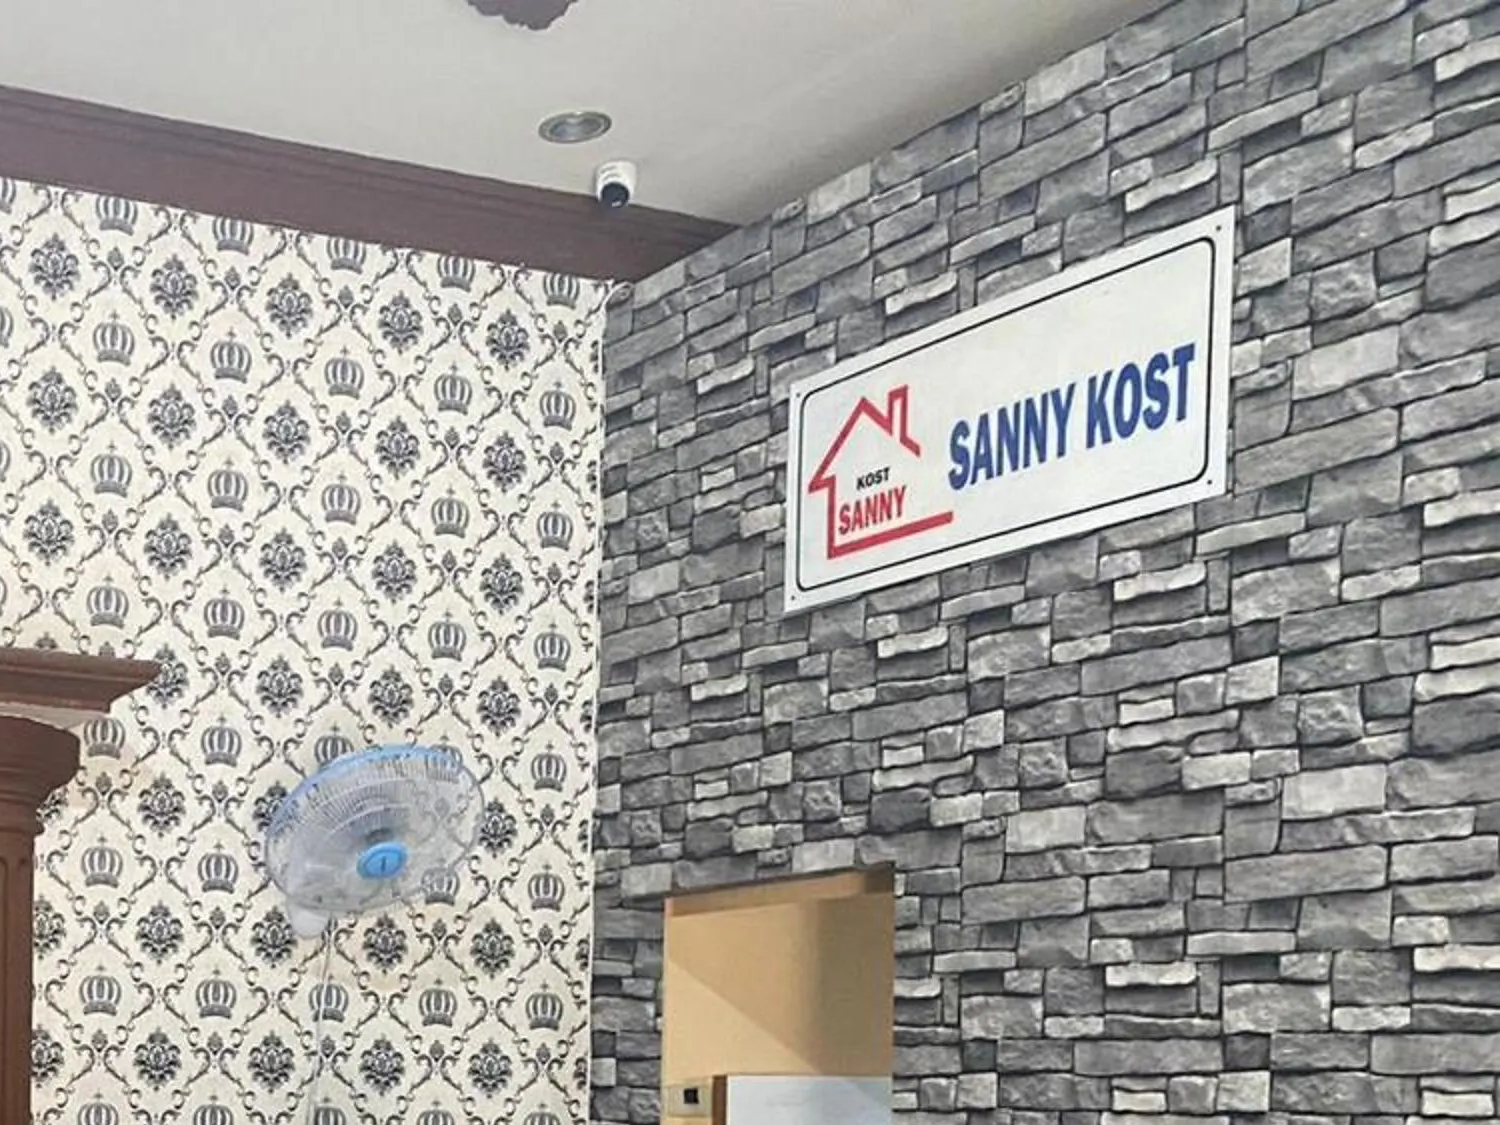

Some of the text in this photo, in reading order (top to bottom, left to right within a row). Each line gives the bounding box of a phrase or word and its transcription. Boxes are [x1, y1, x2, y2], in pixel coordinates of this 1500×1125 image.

[948, 342, 1196, 491] SANNY KOST
[856, 466, 891, 491] KOST
[838, 485, 907, 535] SANNY
